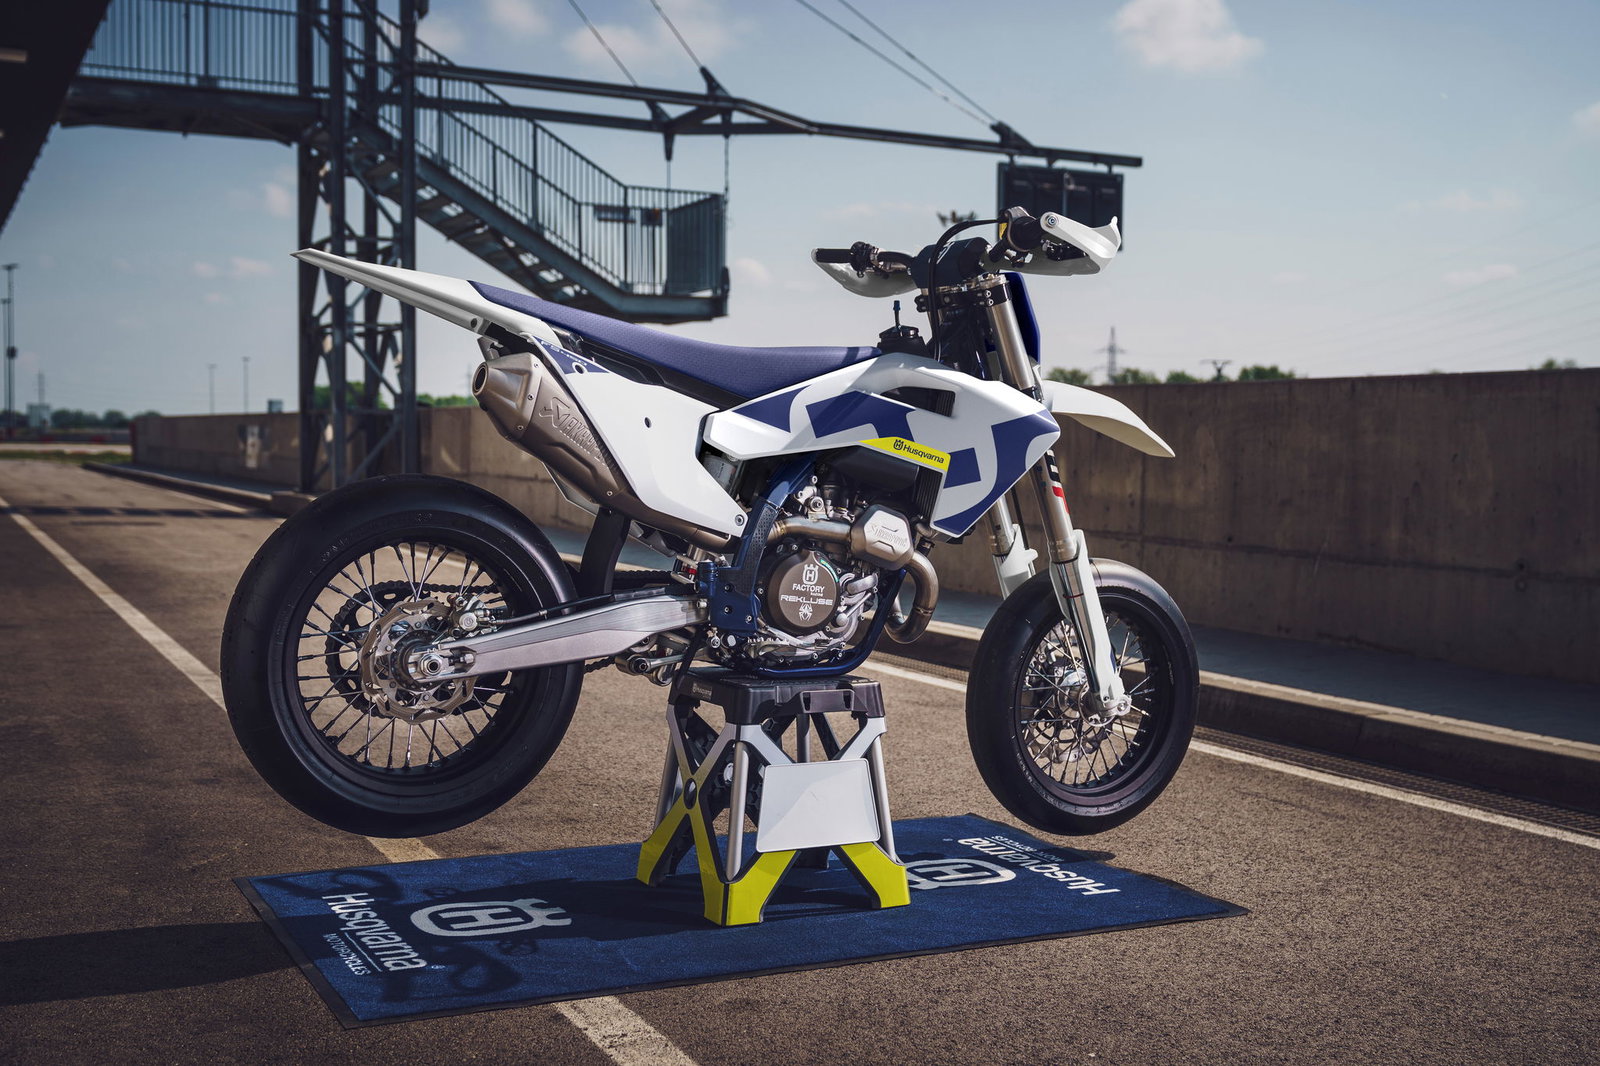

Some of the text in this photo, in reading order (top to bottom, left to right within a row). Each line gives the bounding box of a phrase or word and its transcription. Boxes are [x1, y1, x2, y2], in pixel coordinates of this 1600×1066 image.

[903, 443, 945, 464] Husqvarna
[780, 594, 833, 606] REKLUSE
[792, 583, 825, 593] FACTORY
[991, 835, 1065, 862] MOTRCYCLES
[957, 837, 1121, 896] Husqvarna
[322, 892, 428, 972] Husqvarna
[323, 933, 372, 976] MOTORCYCLES
